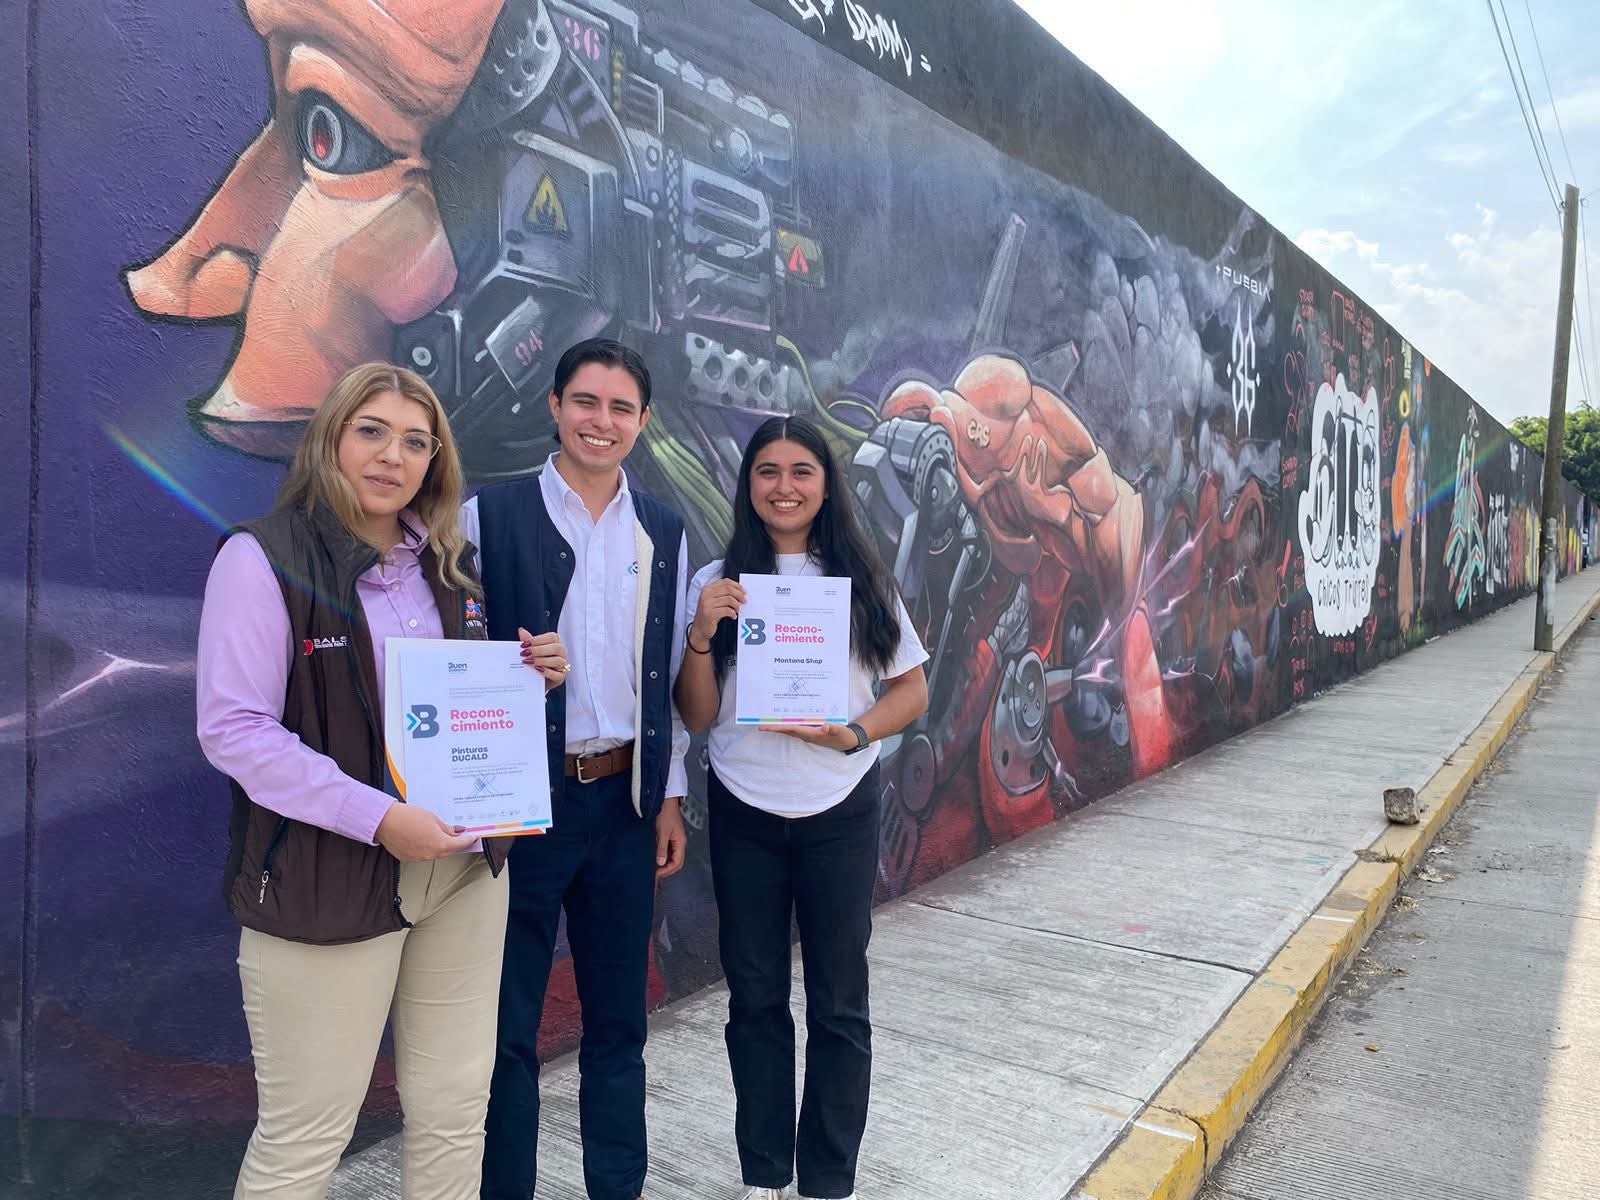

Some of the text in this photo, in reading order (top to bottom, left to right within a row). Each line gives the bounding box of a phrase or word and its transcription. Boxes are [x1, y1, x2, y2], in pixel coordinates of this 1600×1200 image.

[565, 16, 600, 62] 36
[774, 623, 822, 633] Recono-
[774, 633, 825, 643] cimiento
[450, 708, 511, 721] Recono-
[450, 719, 514, 732] cimiento
[451, 746, 488, 755] Pinturas
